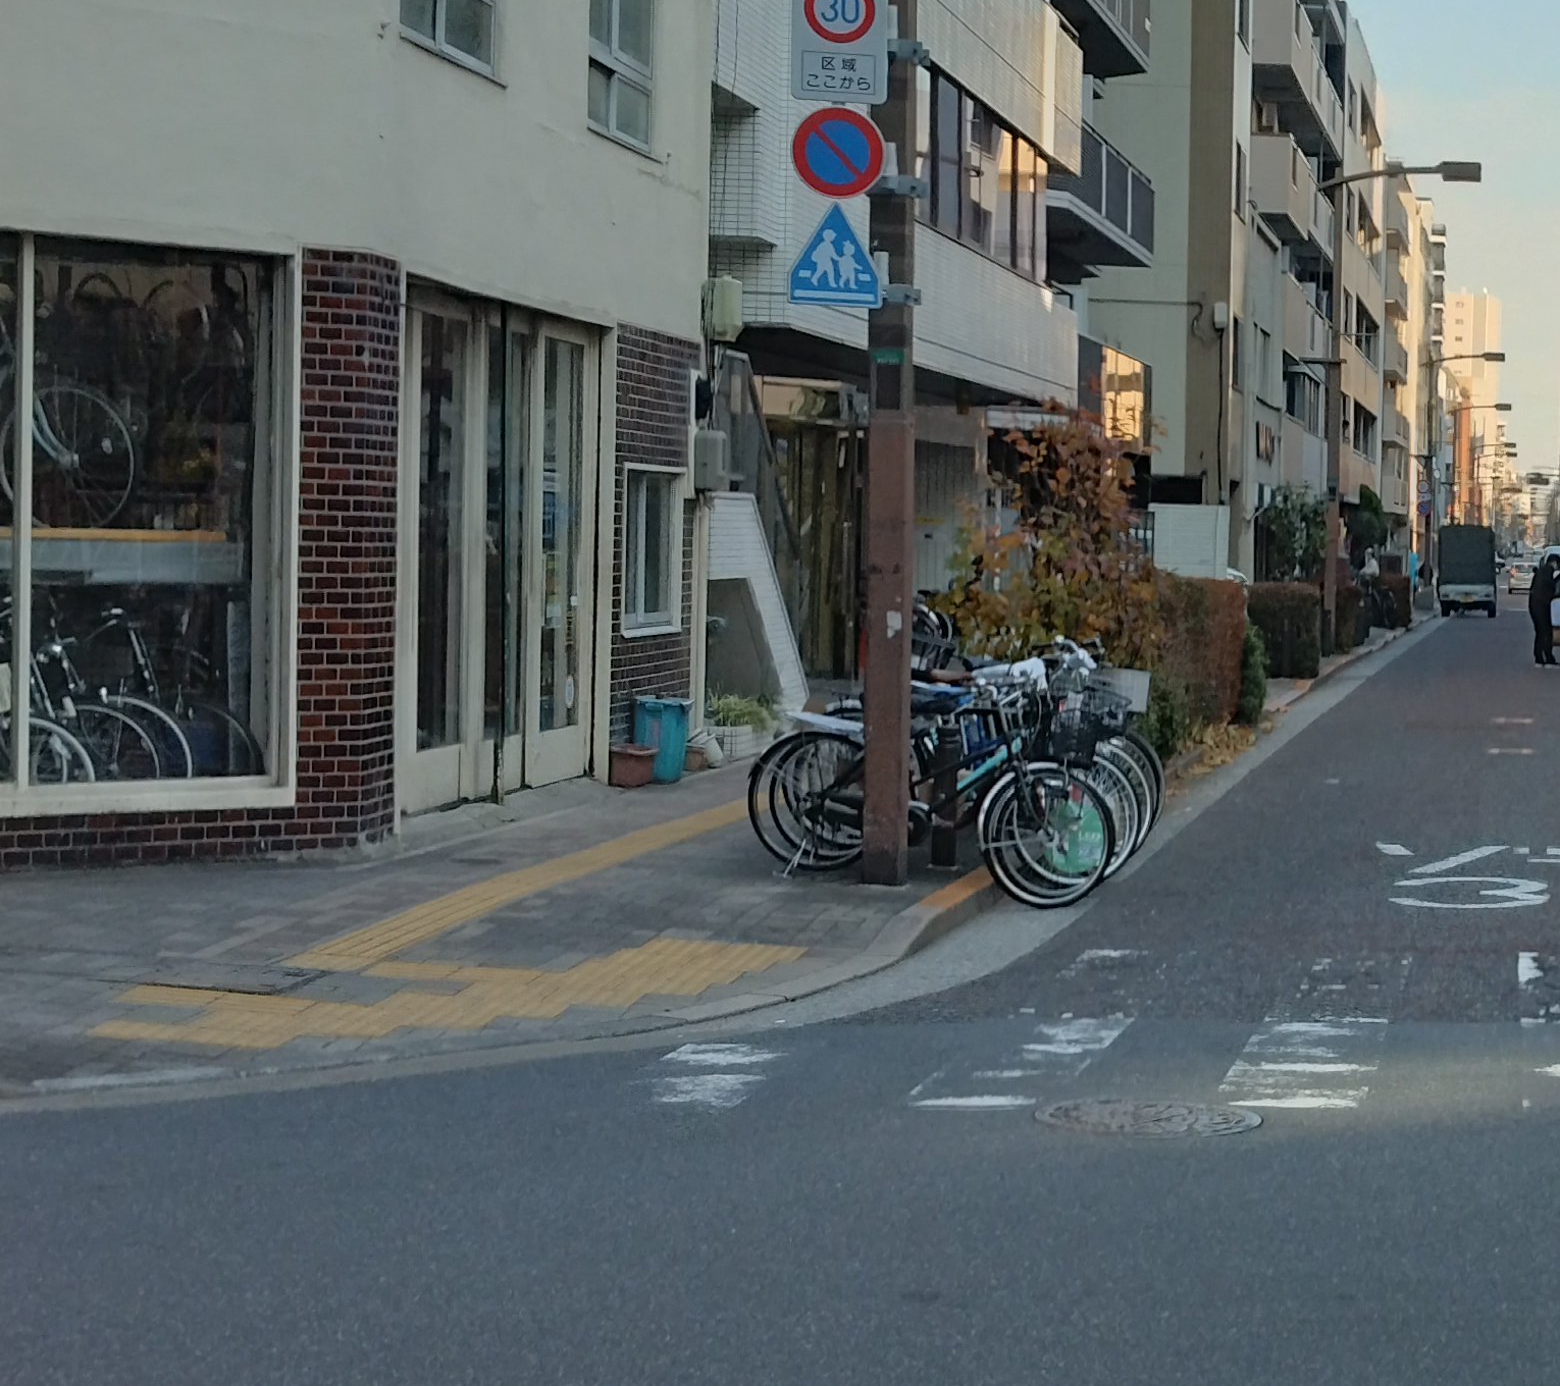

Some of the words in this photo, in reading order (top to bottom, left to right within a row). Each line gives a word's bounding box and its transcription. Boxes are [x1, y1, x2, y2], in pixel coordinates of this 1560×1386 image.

[821, 56, 856, 72] 区域
[806, 73, 871, 91] ここから
